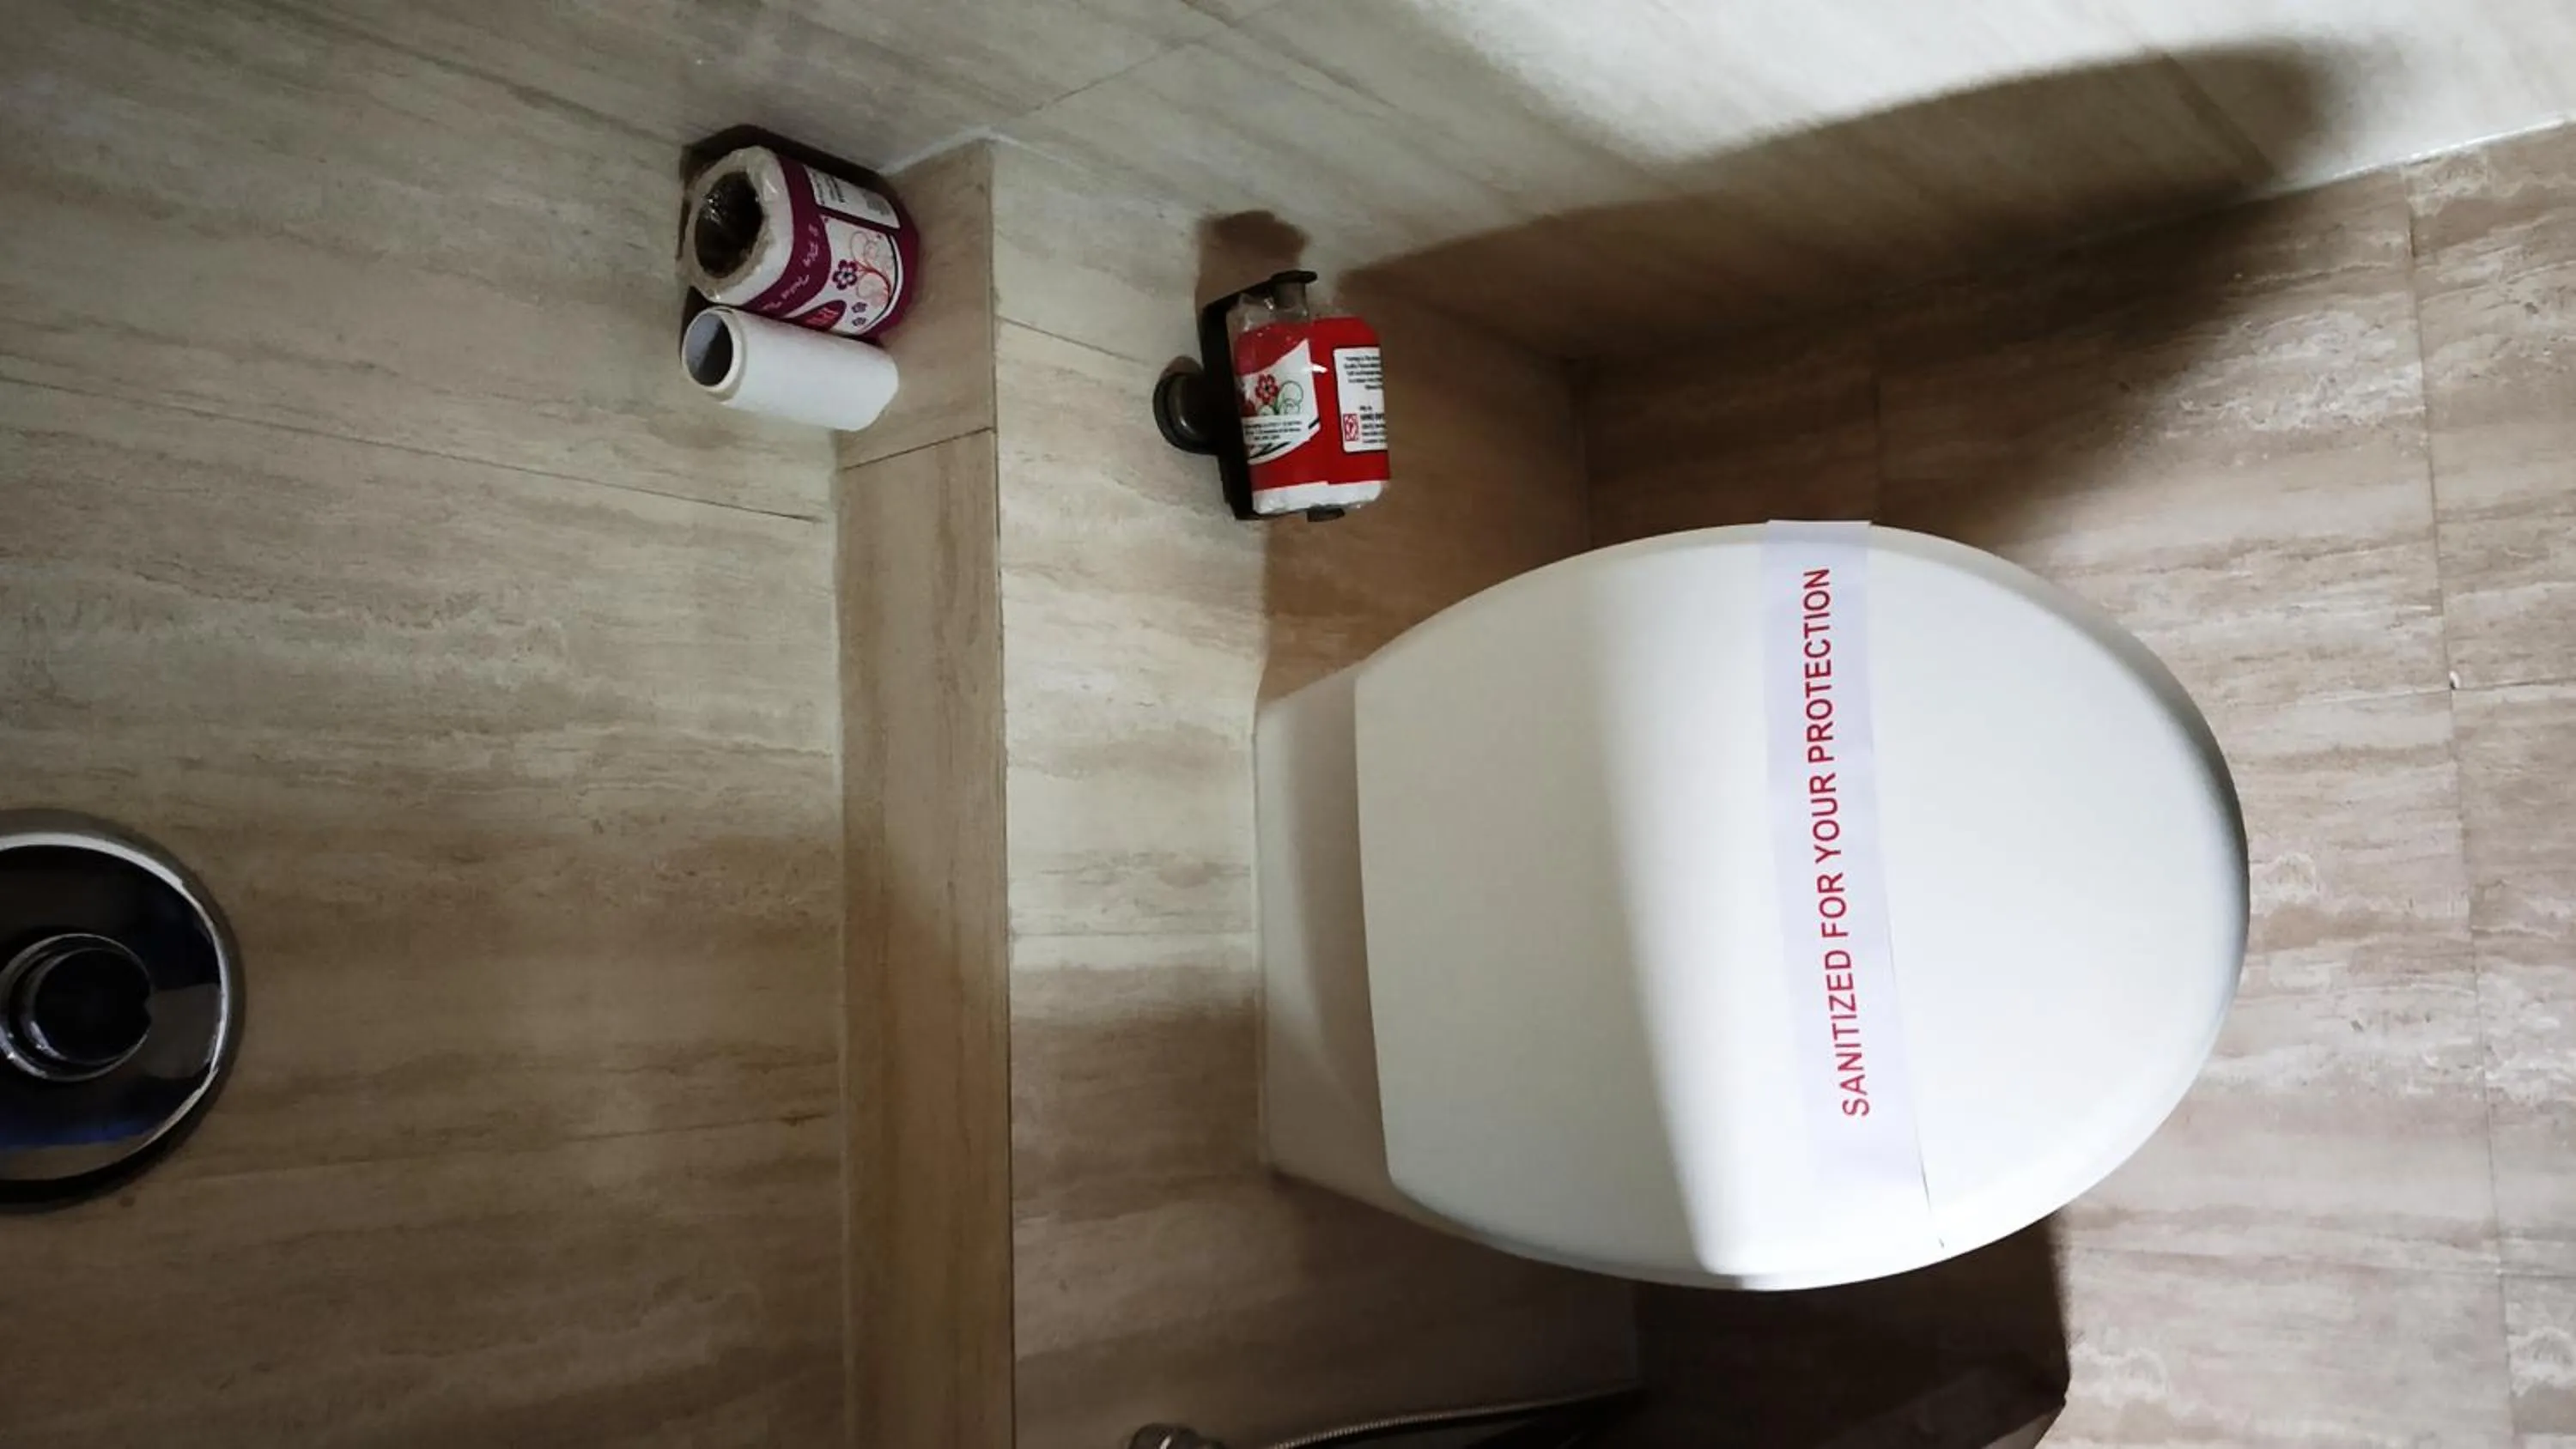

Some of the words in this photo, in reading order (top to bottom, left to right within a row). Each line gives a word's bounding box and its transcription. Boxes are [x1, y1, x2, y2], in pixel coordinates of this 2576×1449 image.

[1801, 567, 1835, 765] PROTECTION
[1807, 772, 1842, 864] YOUR
[1815, 872, 1848, 939] FOR
[1823, 949, 1869, 1117] SANITIZED
